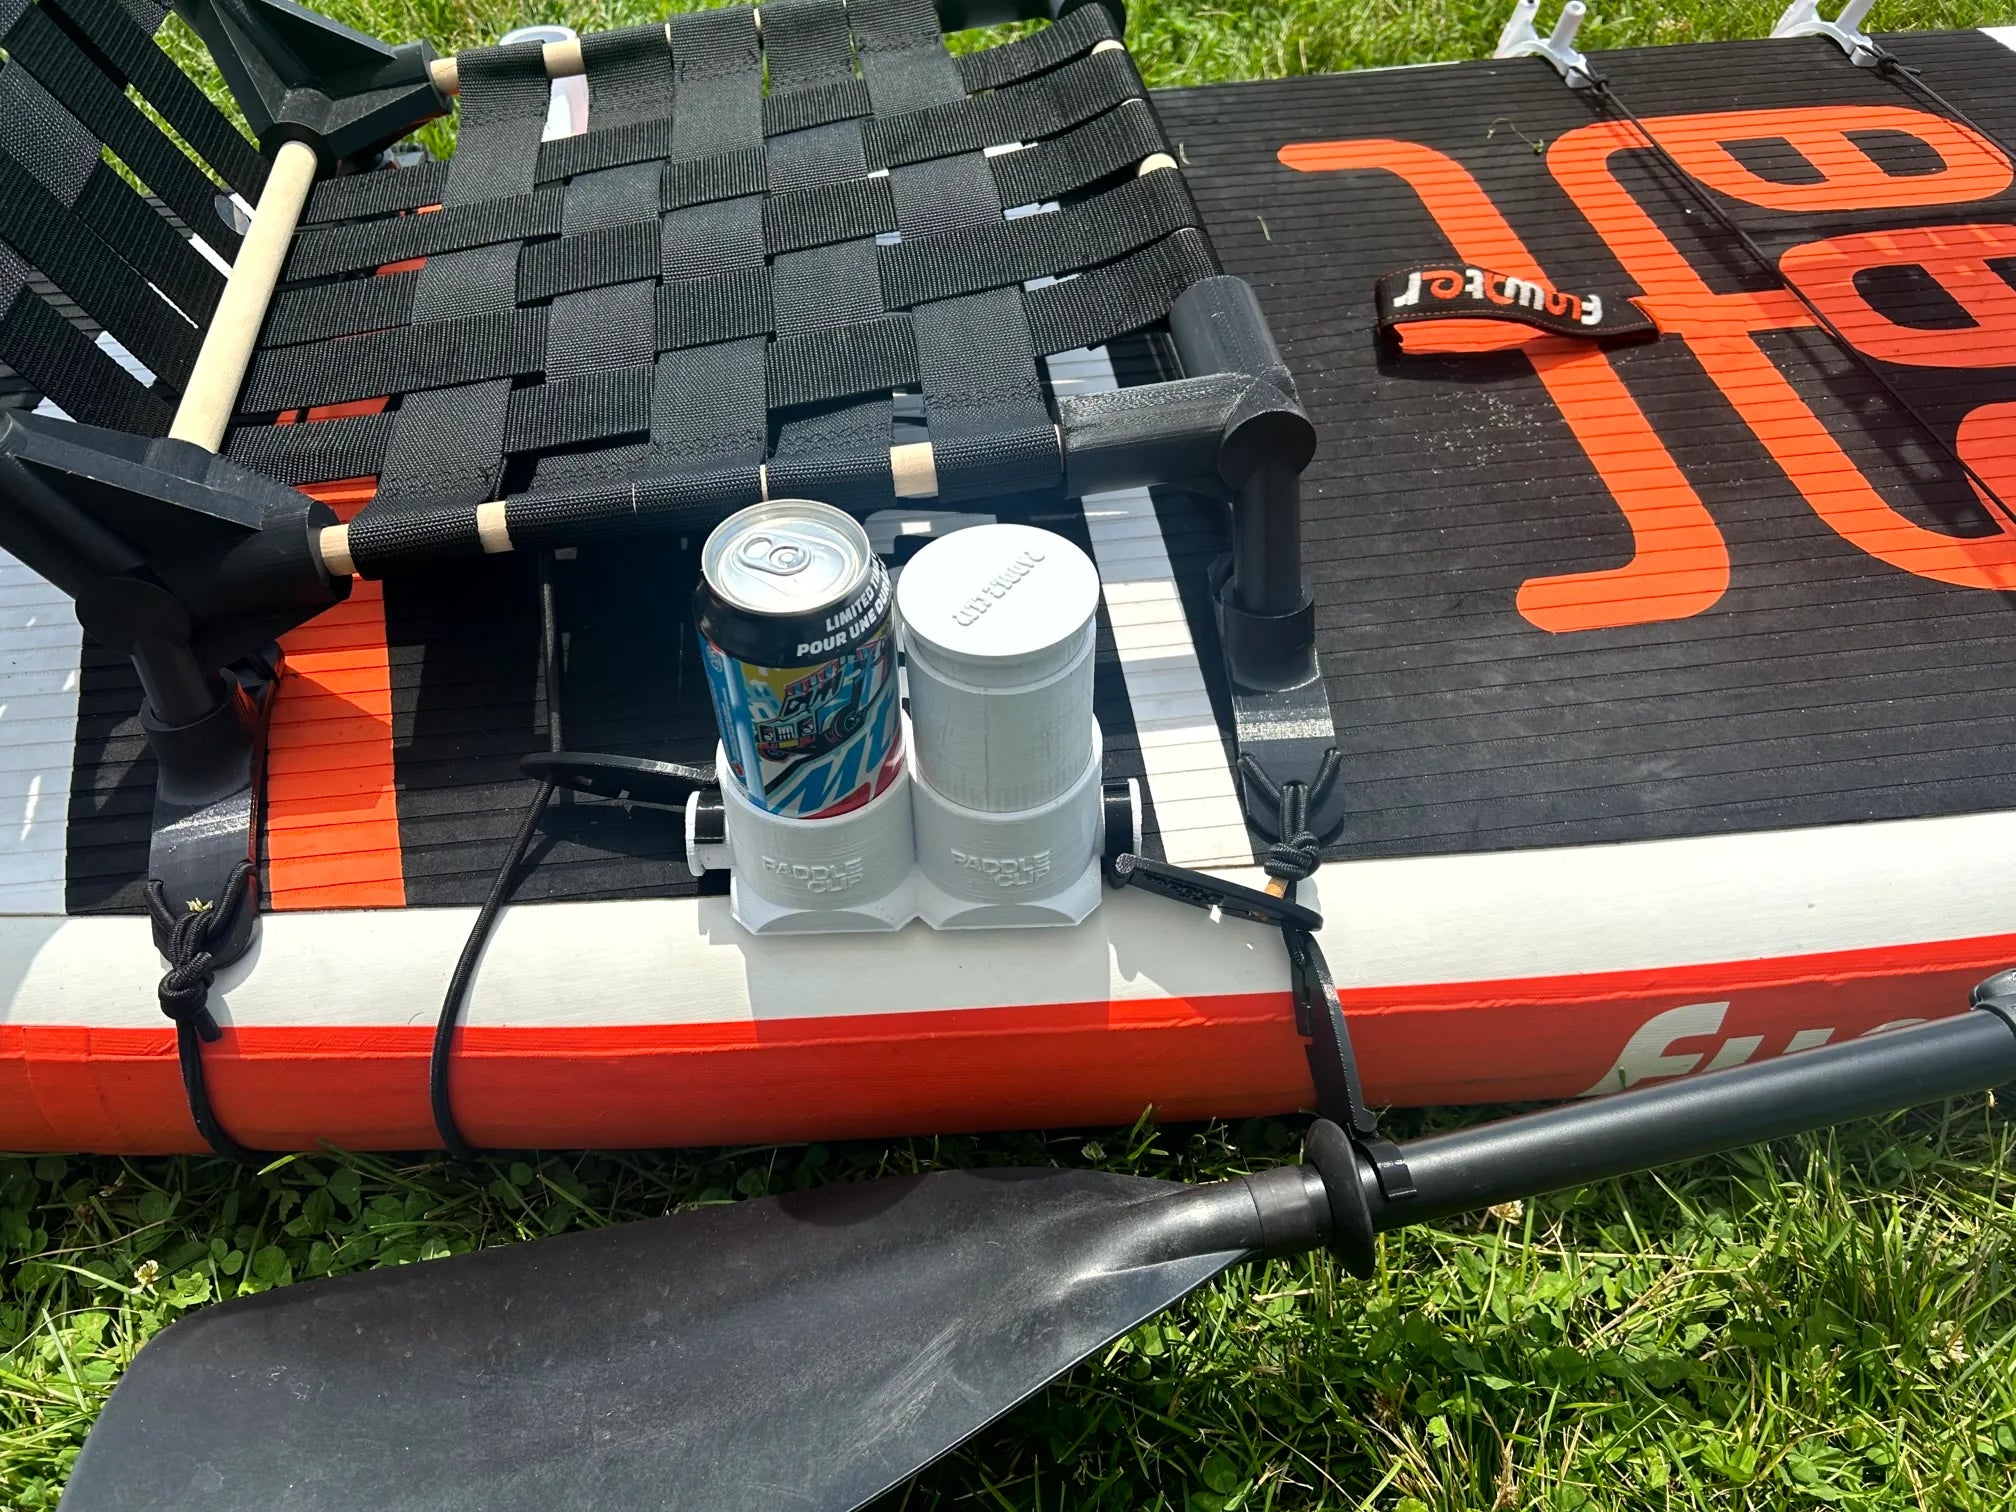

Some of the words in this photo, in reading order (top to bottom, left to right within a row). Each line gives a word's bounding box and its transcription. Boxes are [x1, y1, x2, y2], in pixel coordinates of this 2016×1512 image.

[826, 586, 875, 632] LIMITED
[796, 631, 848, 657] POUR
[849, 608, 877, 640] UNE
[762, 854, 864, 881] PADDLE
[950, 848, 1051, 874] PADDLE
[808, 871, 863, 893] CLIP
[995, 866, 1050, 887] CLIP
